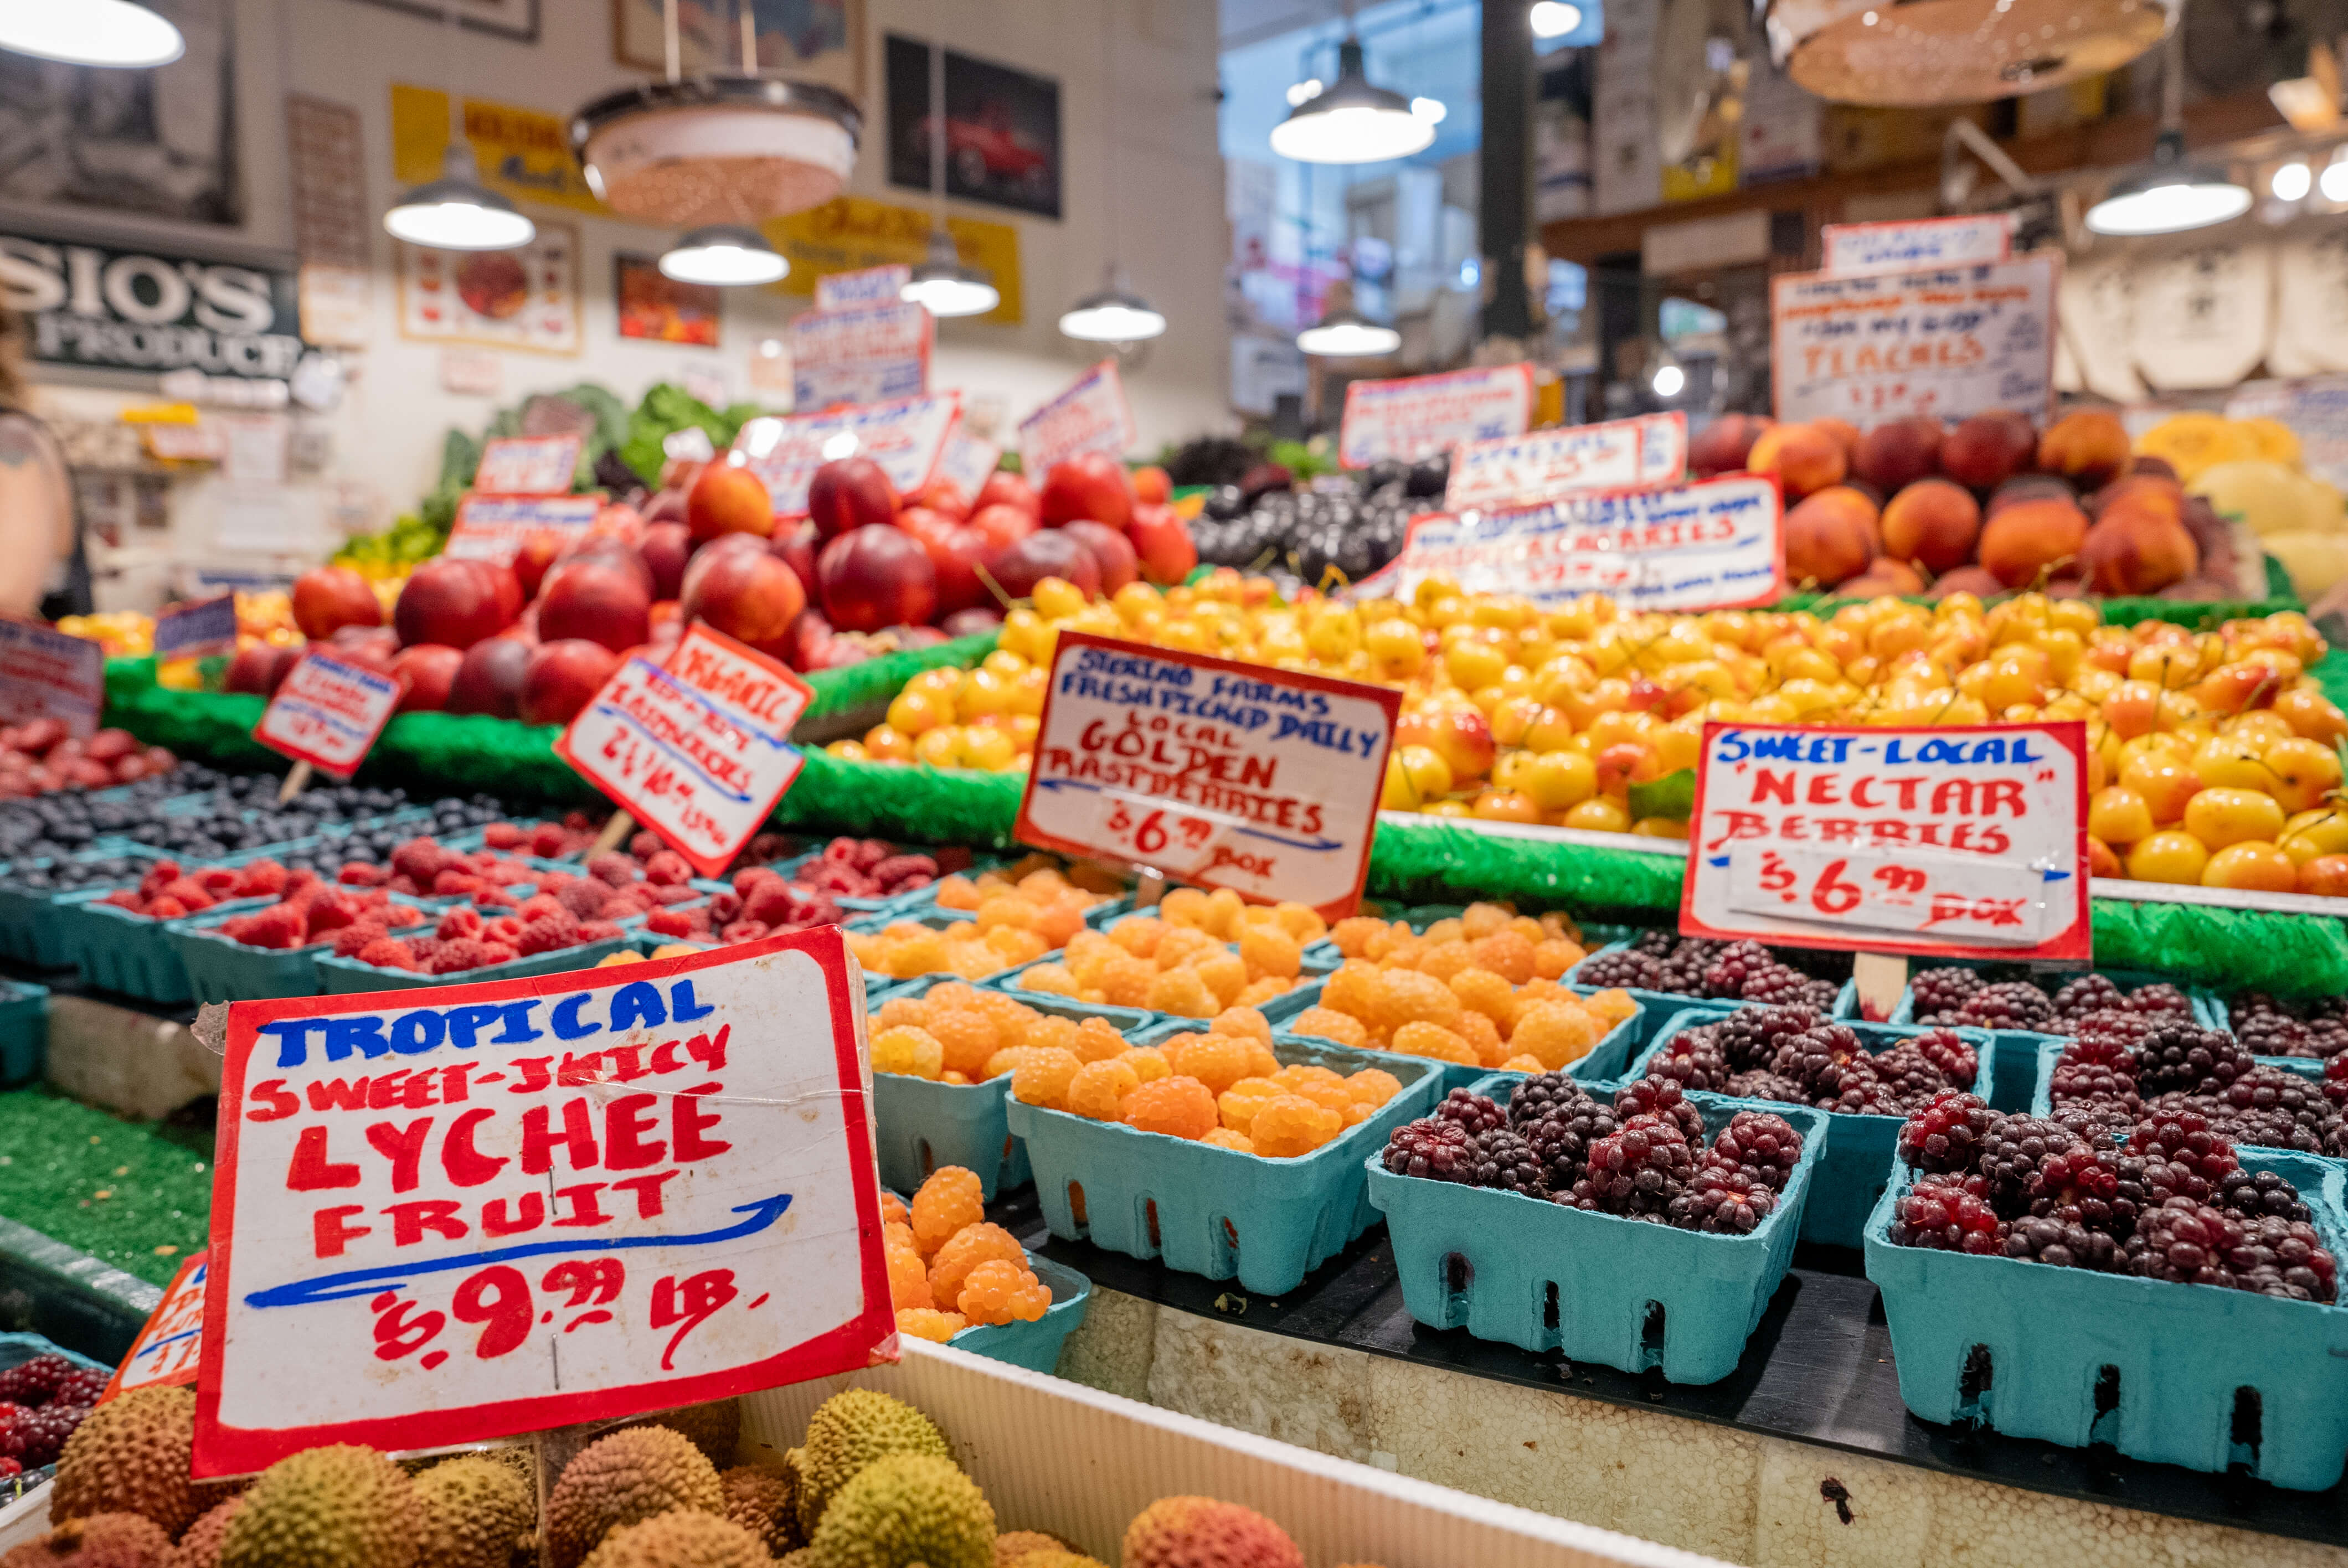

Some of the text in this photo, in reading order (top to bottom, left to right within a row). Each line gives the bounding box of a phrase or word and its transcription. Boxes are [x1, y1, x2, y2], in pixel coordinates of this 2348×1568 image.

[684, 648, 791, 724] RGANIC
[1062, 672, 1379, 757] FRESH PICKED DAILY
[1213, 676, 1330, 716] FARMS
[1080, 719, 1278, 790] GOLDEN
[1127, 710, 1242, 749] LOCAL
[1046, 747, 1324, 833] RASPBERRIES
[1193, 846, 1276, 879] BOX
[1704, 810, 2012, 857] BERRIES
[1914, 891, 2028, 932] BOX
[258, 978, 715, 1068] TROPICAL
[245, 1023, 731, 1123] SWEET-JUICY
[285, 1080, 733, 1194] LYCHEE
[312, 1168, 681, 1260] FRUIT
[369, 1256, 626, 1371] $9.99
